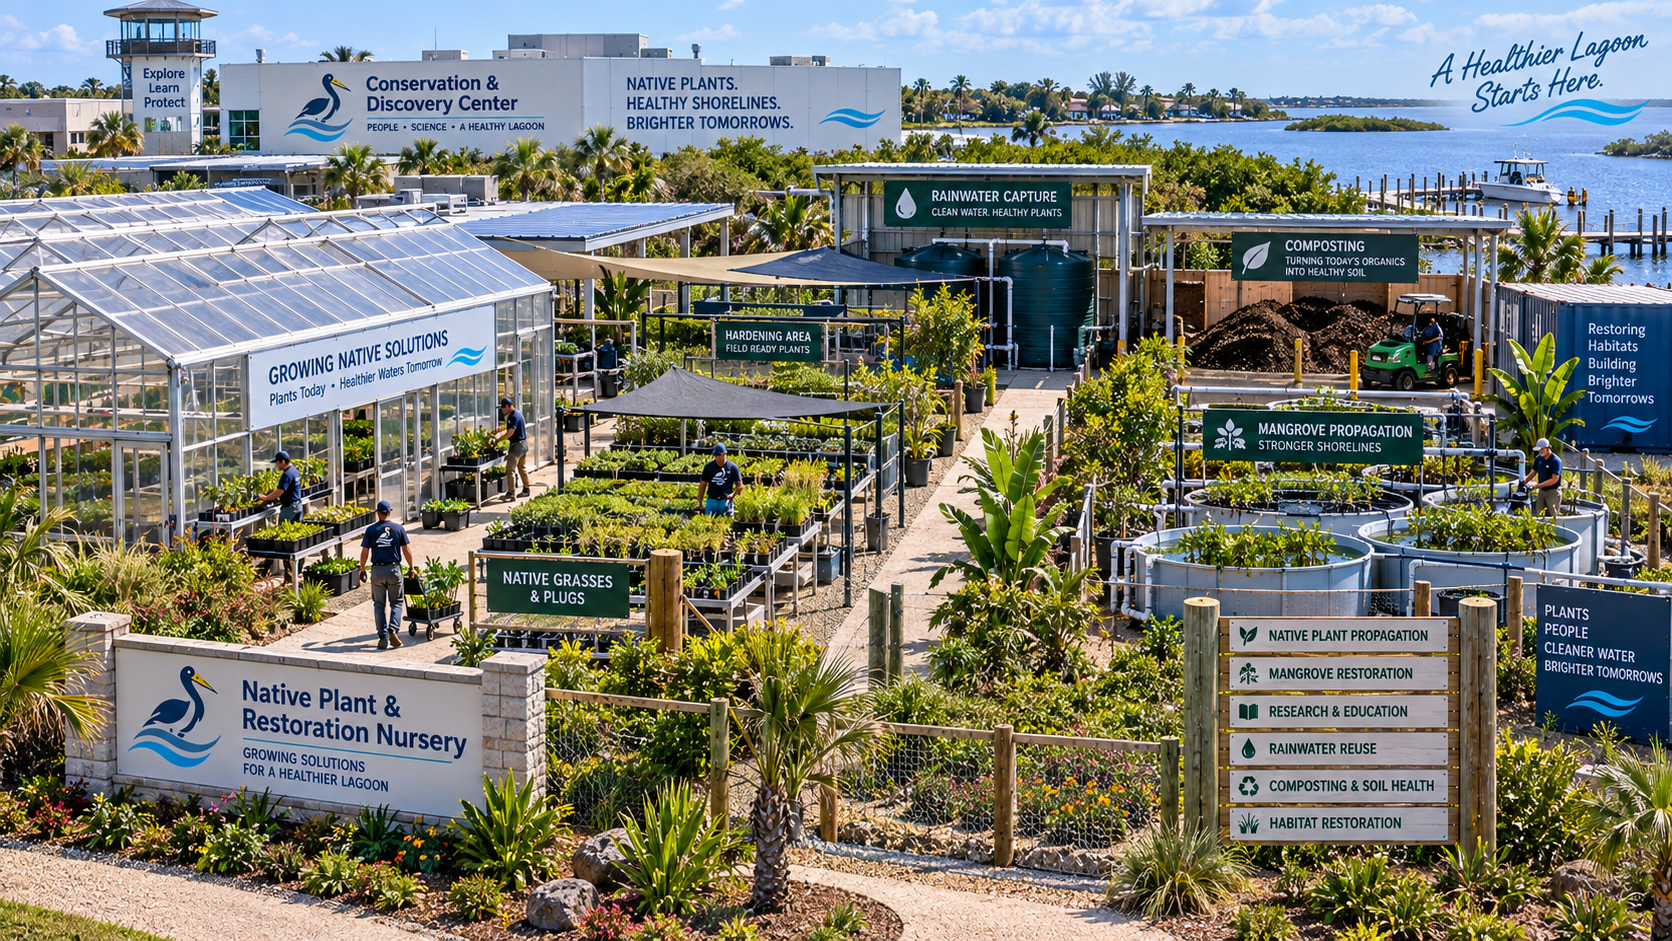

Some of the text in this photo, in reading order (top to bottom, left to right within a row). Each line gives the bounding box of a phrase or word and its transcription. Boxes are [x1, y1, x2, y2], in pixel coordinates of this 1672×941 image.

[144, 68, 185, 81] Explore
[149, 83, 179, 93] Learn
[366, 75, 499, 91] Conservation &
[627, 77, 737, 90] NATIVE PLANTS.
[145, 97, 185, 108] Protect
[367, 95, 518, 115] Discovery Center
[627, 96, 780, 110] HEALTHY SHORELINES.
[411, 123, 446, 131] SCIENCE
[460, 123, 465, 131] A
[469, 123, 505, 131] HEALTHY
[509, 122, 544, 130] LAGOON
[627, 116, 793, 129] BRIGHTER TOMORROWS.
[932, 190, 1056, 202] RAINWATER CAPTURE
[932, 208, 1062, 217] CLEAN WATER. HEALTHY PLANTS
[1286, 240, 1364, 251] COMPOSTING
[1286, 256, 1323, 265] TURNING
[1362, 257, 1405, 266] ORGANICS
[1308, 268, 1344, 276] HEALTHY
[1347, 268, 1366, 276] SOIL
[726, 330, 811, 342] HARDENING AREA
[1589, 323, 1645, 338] Restoring
[726, 344, 810, 353] FIELD READY PLANTS
[1589, 340, 1638, 352] Habitats
[268, 329, 449, 385] GROWING NATIVE SOLUTIONS
[1589, 358, 1636, 373] Building
[269, 357, 443, 406] Plants Today Healthier Waters Tomorrow
[1588, 374, 1637, 390] Brighter
[1587, 391, 1654, 404] Tomorrows
[1259, 422, 1412, 437] MANGROVE PROPAGATION
[1259, 440, 1381, 452] STRONGER SHORELINES
[504, 571, 612, 588] NATIVE GRASSES
[531, 590, 584, 604] & PLUGS
[1545, 605, 1589, 620] PLANTS
[1269, 630, 1428, 641] NATIVE PLANT PROPAGATION
[1545, 623, 1588, 639] PEOPLE
[1544, 641, 1635, 663] CLEANER WATER
[1270, 668, 1412, 679] MANGROVE RESTORATION
[1544, 660, 1663, 684] BRIGHTER TOMORROWS
[242, 680, 401, 718] Native Plant &
[1270, 706, 1407, 717] RESEARCH & EDUCATION
[243, 708, 467, 759] Restoration Nursery
[1270, 743, 1376, 754] RAINWATER REUSE
[243, 747, 365, 773] GROWING SOLUTIONS
[243, 763, 389, 792] FOR A HEALTHIER LAGOON
[1270, 780, 1434, 791] COMPOSTING & SOIL HEALTH
[1270, 817, 1401, 829] HABITAT RESTORATION
